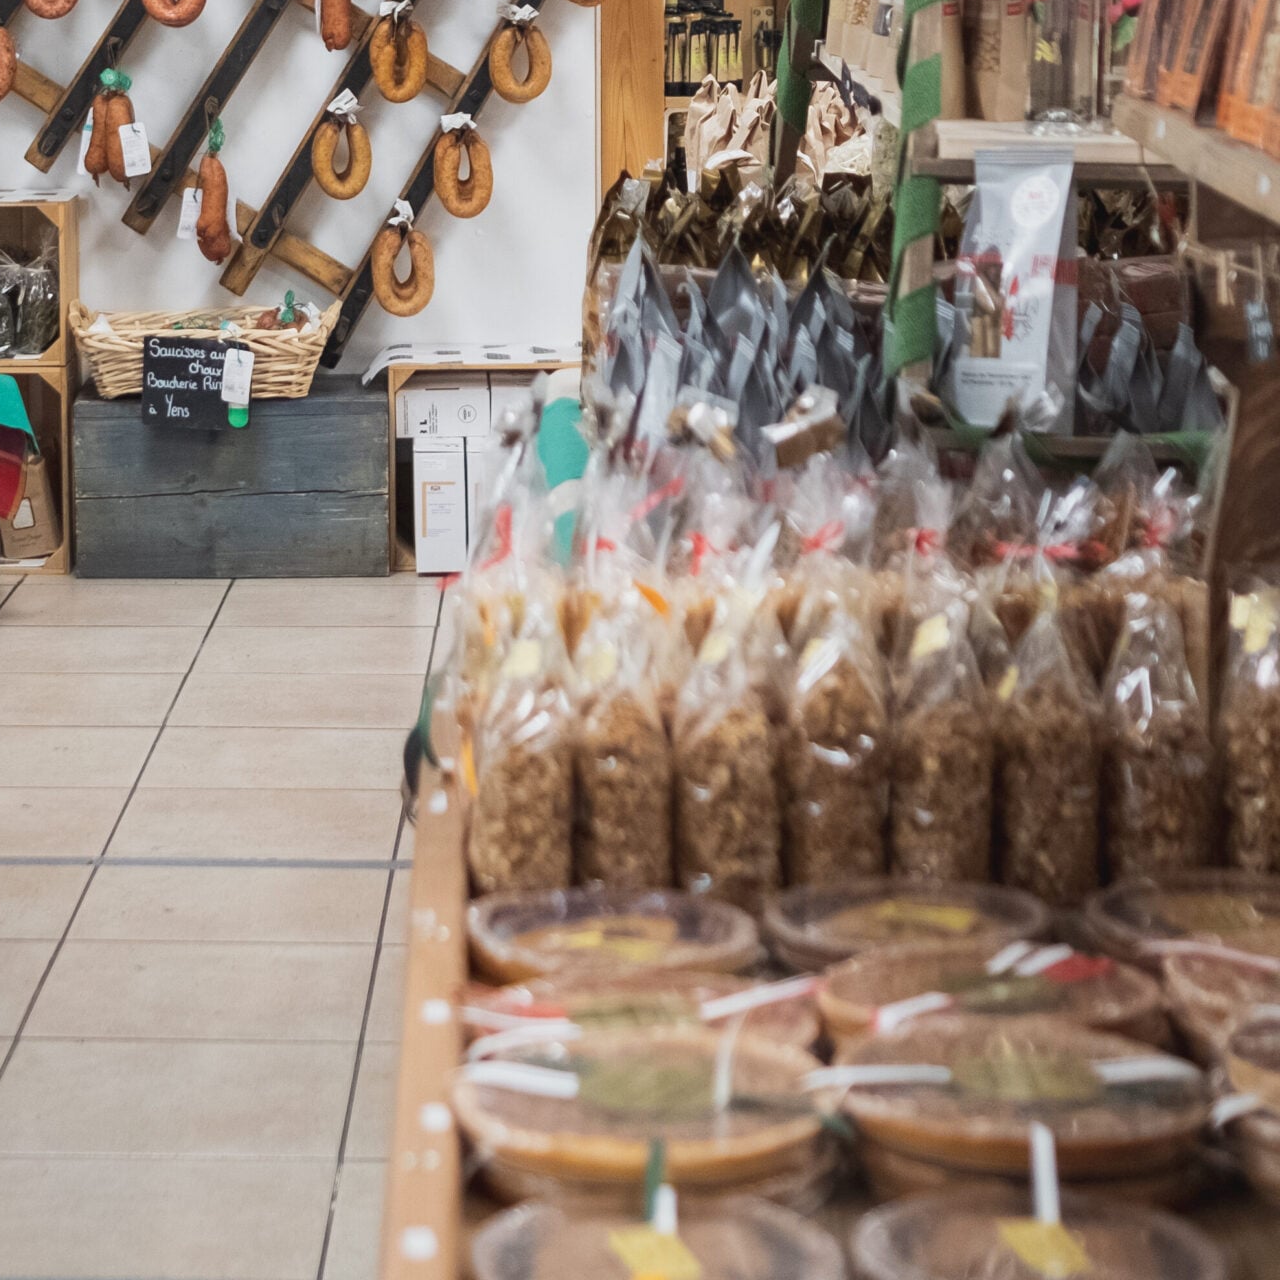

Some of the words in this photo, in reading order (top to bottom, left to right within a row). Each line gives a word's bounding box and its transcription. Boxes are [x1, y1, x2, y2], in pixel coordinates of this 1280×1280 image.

[149, 338, 206, 359] Saucisses
[210, 351, 226, 360] au
[189, 360, 222, 376] choux
[147, 372, 198, 390] Boucherie
[203, 375, 223, 390] Rim
[149, 404, 157, 415] à
[165, 393, 190, 418] Yens
